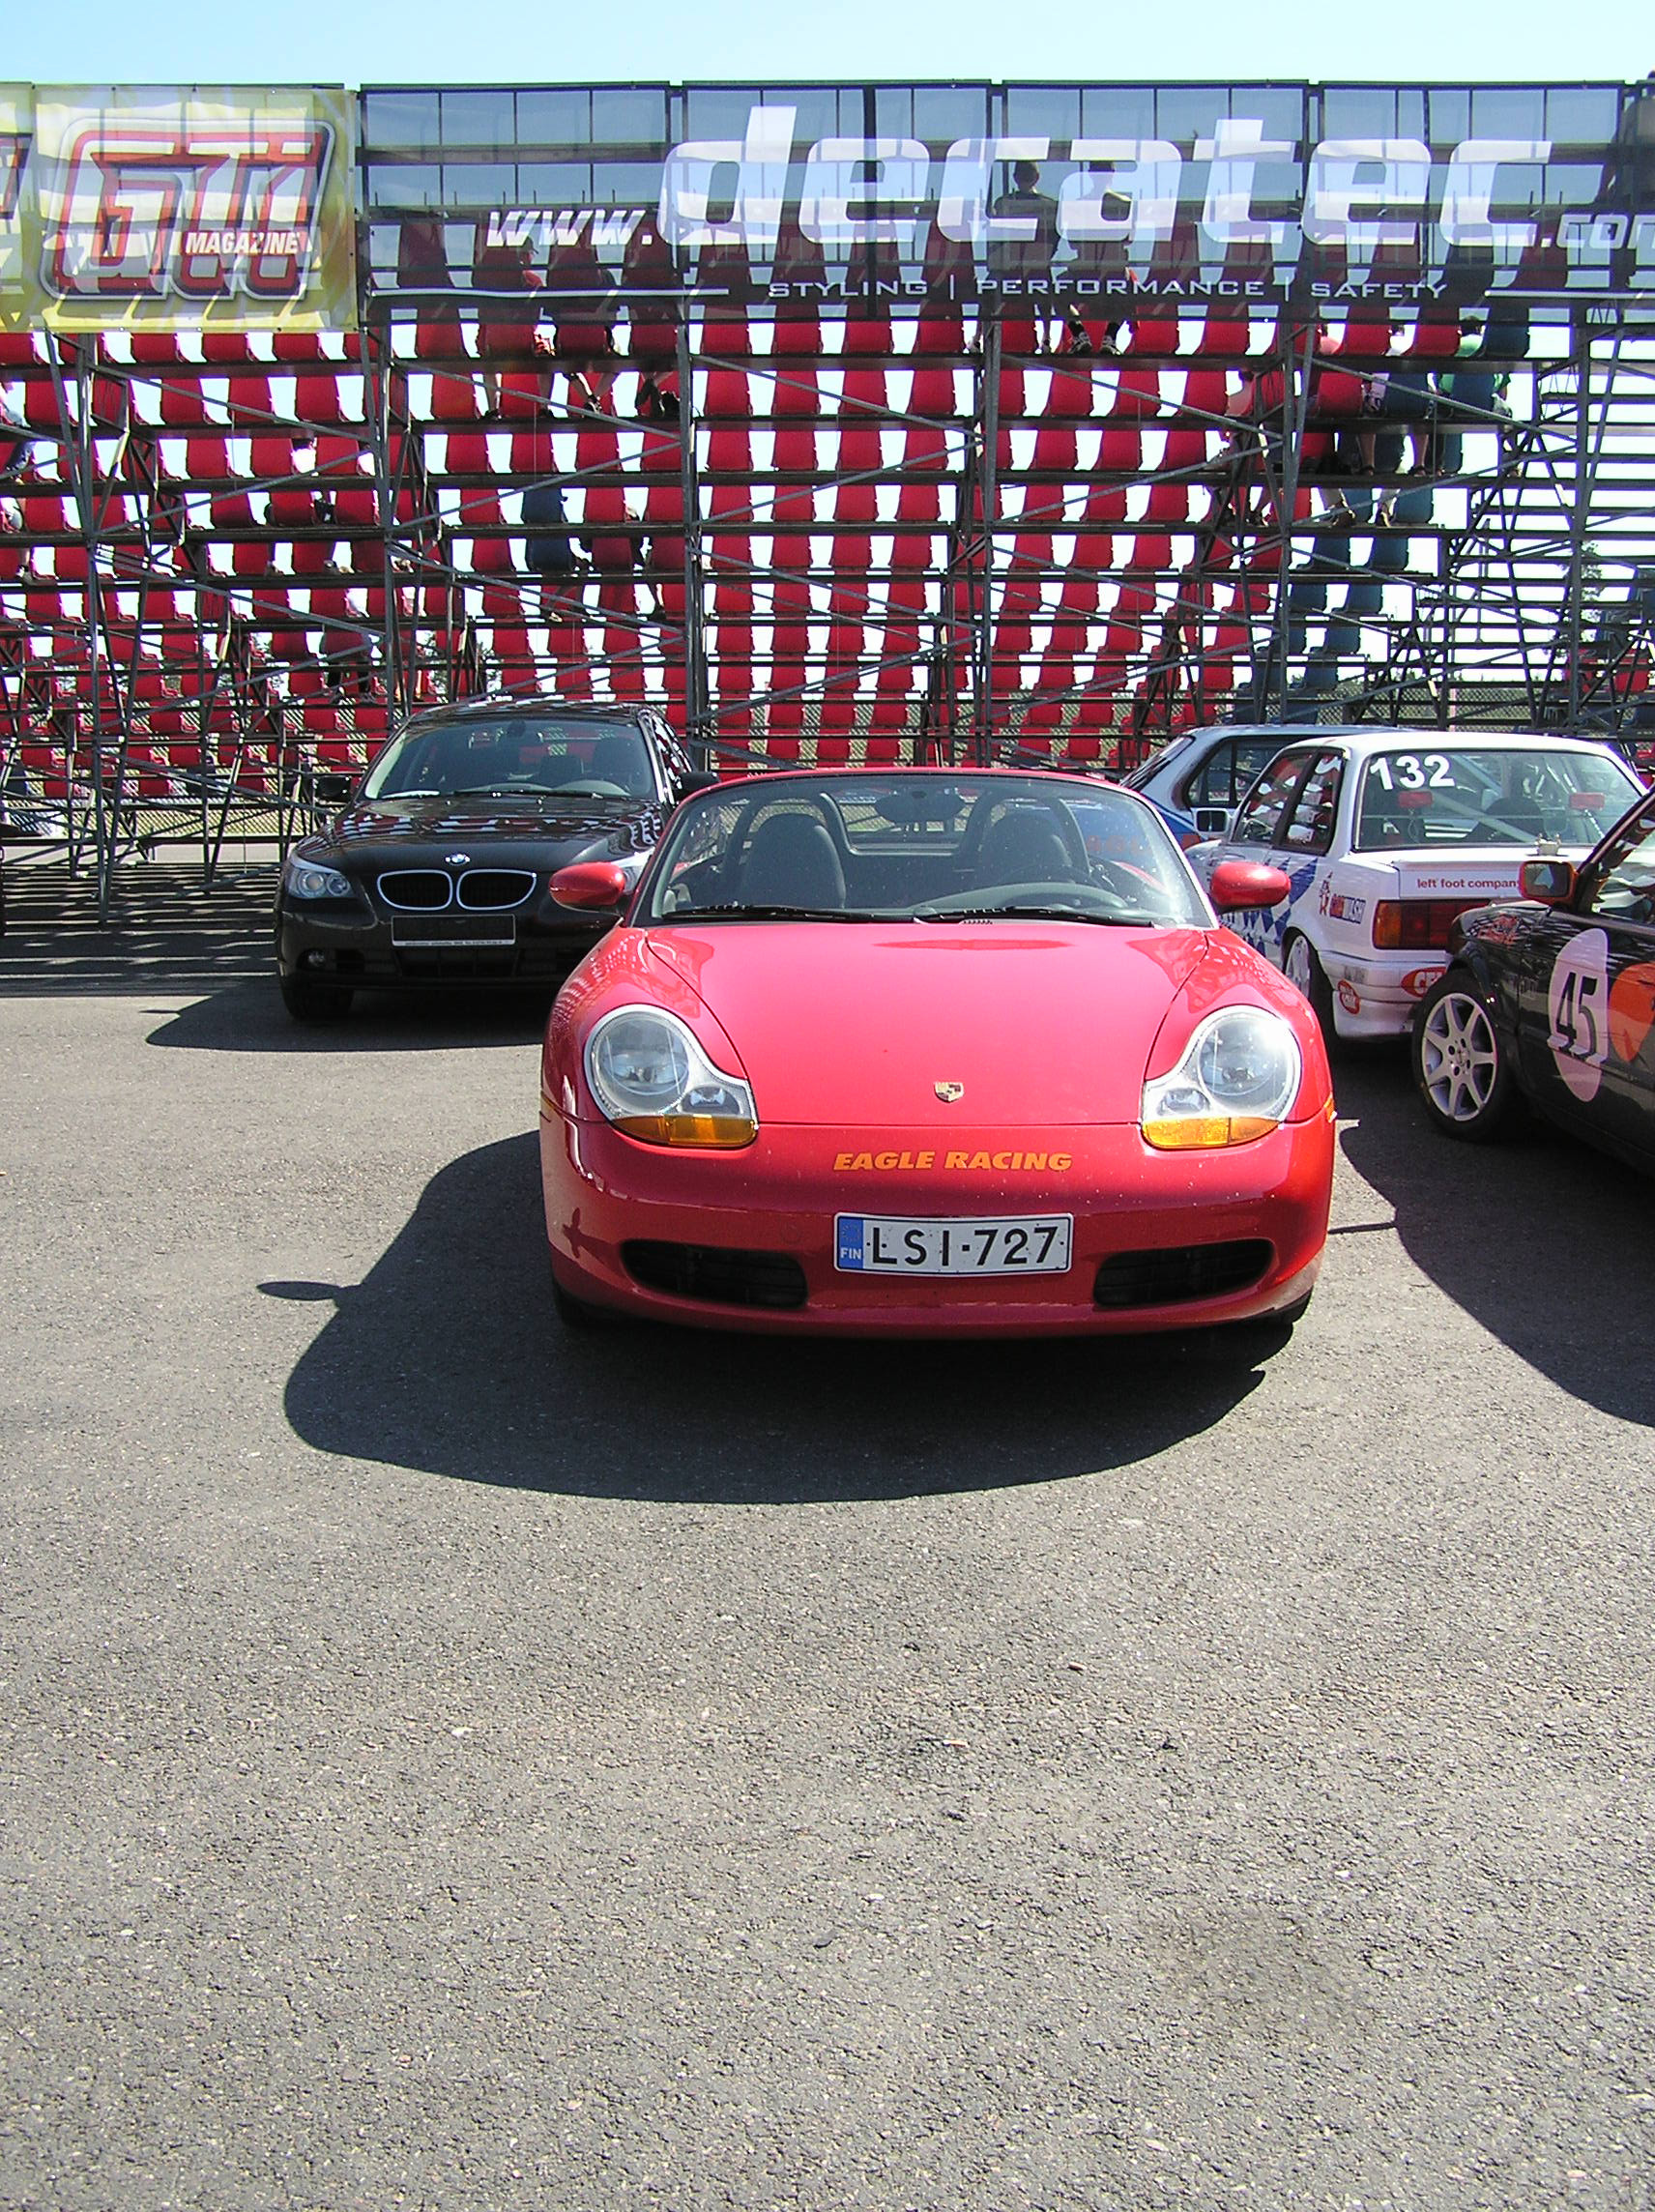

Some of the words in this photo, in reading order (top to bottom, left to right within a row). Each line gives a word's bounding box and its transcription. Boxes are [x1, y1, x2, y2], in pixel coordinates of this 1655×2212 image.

[185, 231, 302, 254] MAGAZINE
[769, 279, 928, 298] STYLING
[976, 278, 1264, 298] PERFORMANCE
[1310, 281, 1448, 299] SAFETY
[1369, 754, 1456, 791] 132
[1417, 878, 1437, 888] left
[1439, 878, 1465, 888] foot
[1466, 880, 1519, 889] compan
[1555, 971, 1598, 1059] 45
[832, 1150, 936, 1171] EAGLE
[944, 1150, 1072, 1172] RACING
[839, 1247, 862, 1260] FIN
[872, 1225, 1060, 1266] LSI-727
